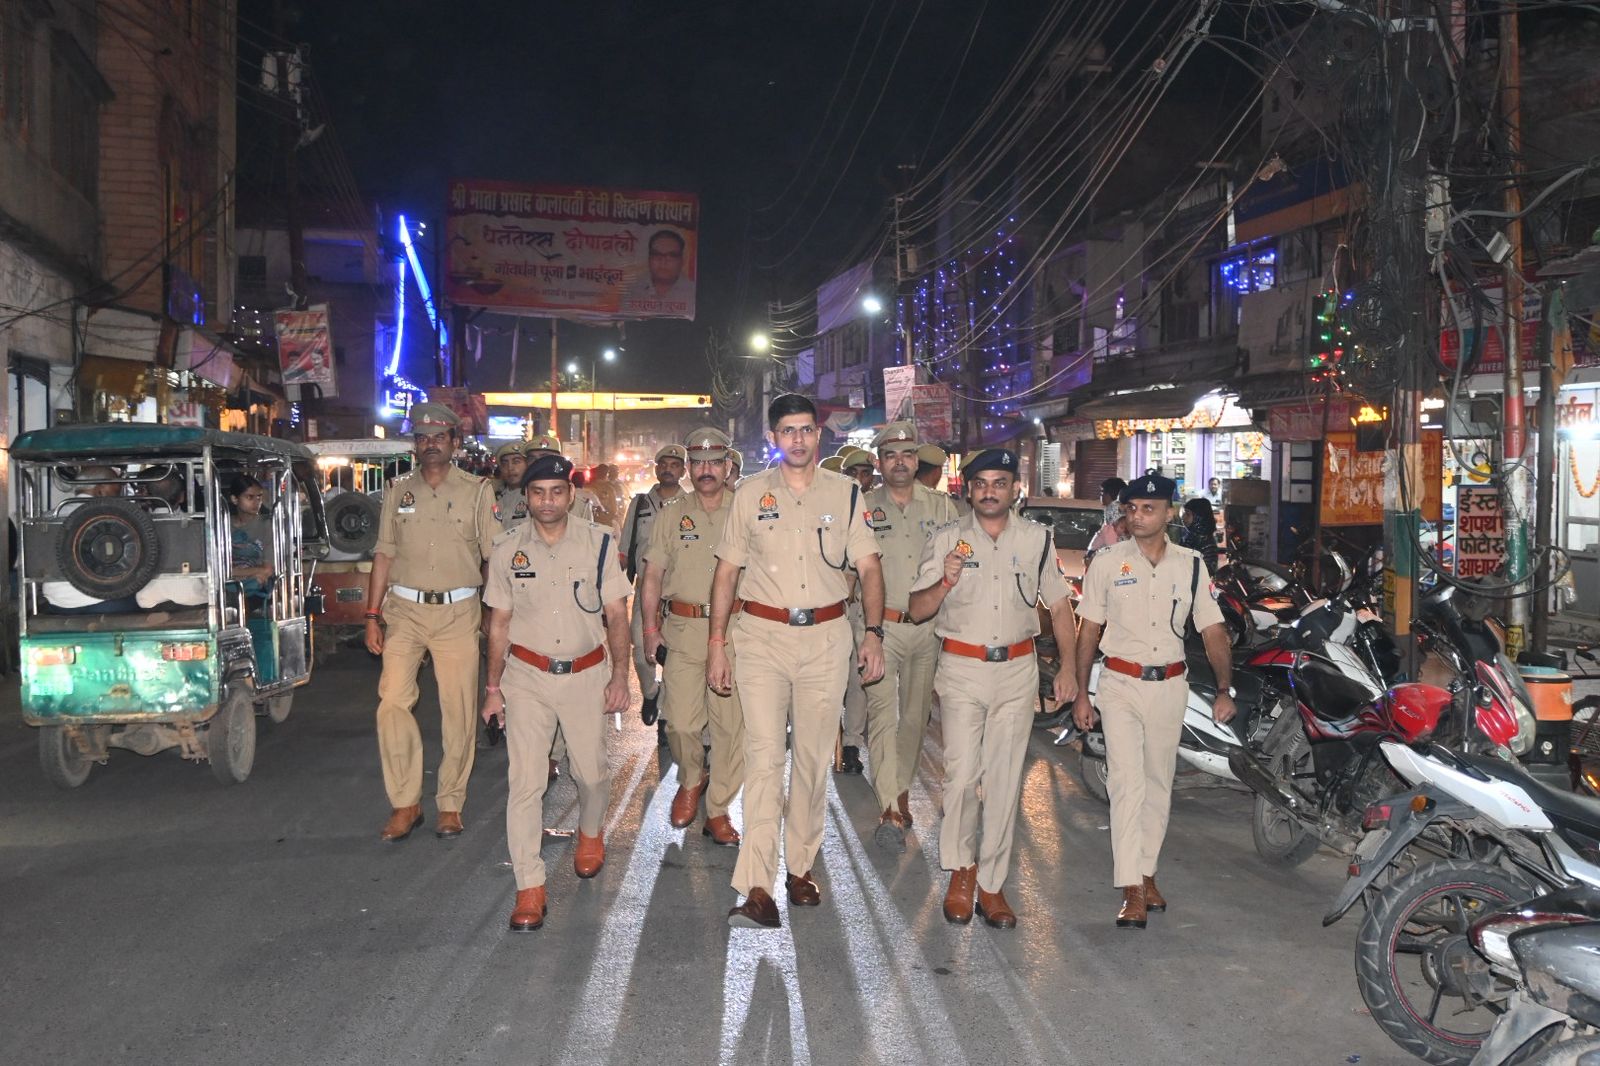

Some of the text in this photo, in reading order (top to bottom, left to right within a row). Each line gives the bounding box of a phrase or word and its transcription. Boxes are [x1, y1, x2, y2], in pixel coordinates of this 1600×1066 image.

[613, 192, 652, 221] शिक्षण
[540, 264, 564, 282] पूजा
[1459, 515, 1497, 533] शपथ
[1459, 533, 1491, 555] फोटो
